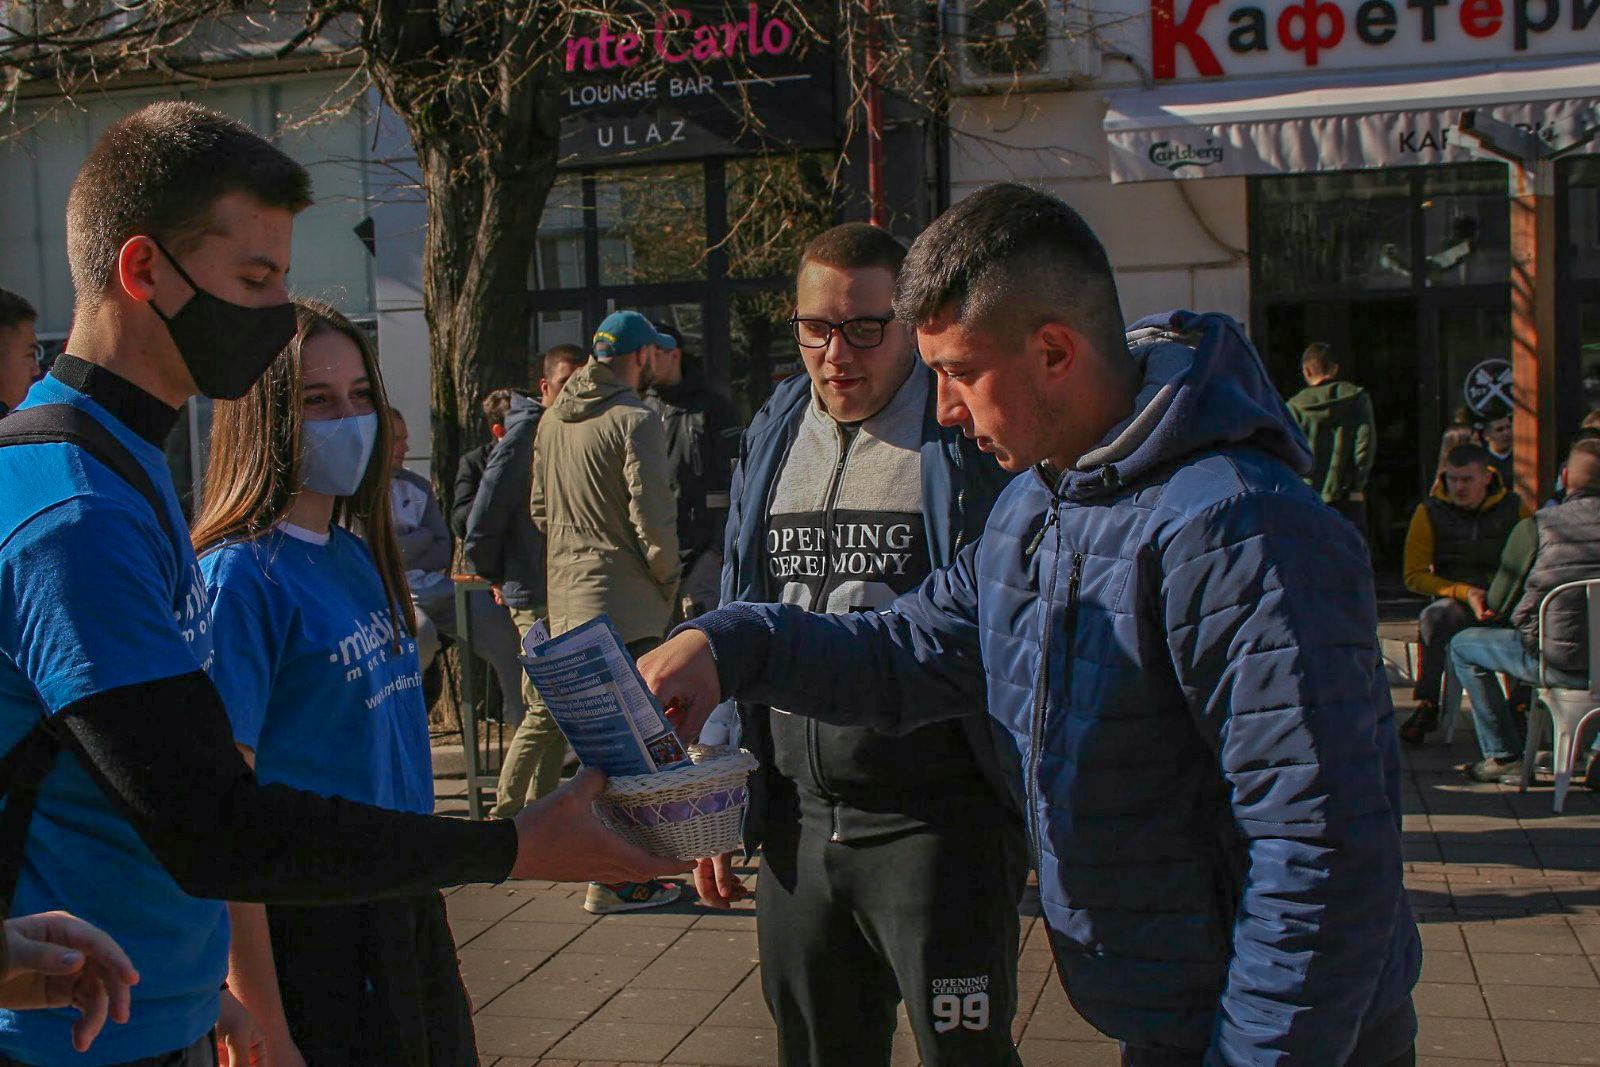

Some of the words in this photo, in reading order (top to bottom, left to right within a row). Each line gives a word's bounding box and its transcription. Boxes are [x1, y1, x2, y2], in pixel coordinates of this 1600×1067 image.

[654, 2, 793, 63] Carlo
[569, 80, 657, 106] LOUNGE
[669, 76, 715, 98] BAR
[598, 120, 687, 147] ULAZ
[1148, 140, 1224, 169] Carlsberg
[768, 523, 914, 554] OPENING
[769, 552, 913, 577] CEREMONY
[932, 975, 989, 988] OPENING
[932, 984, 988, 994] CEREMONY
[933, 991, 990, 1034] 99
